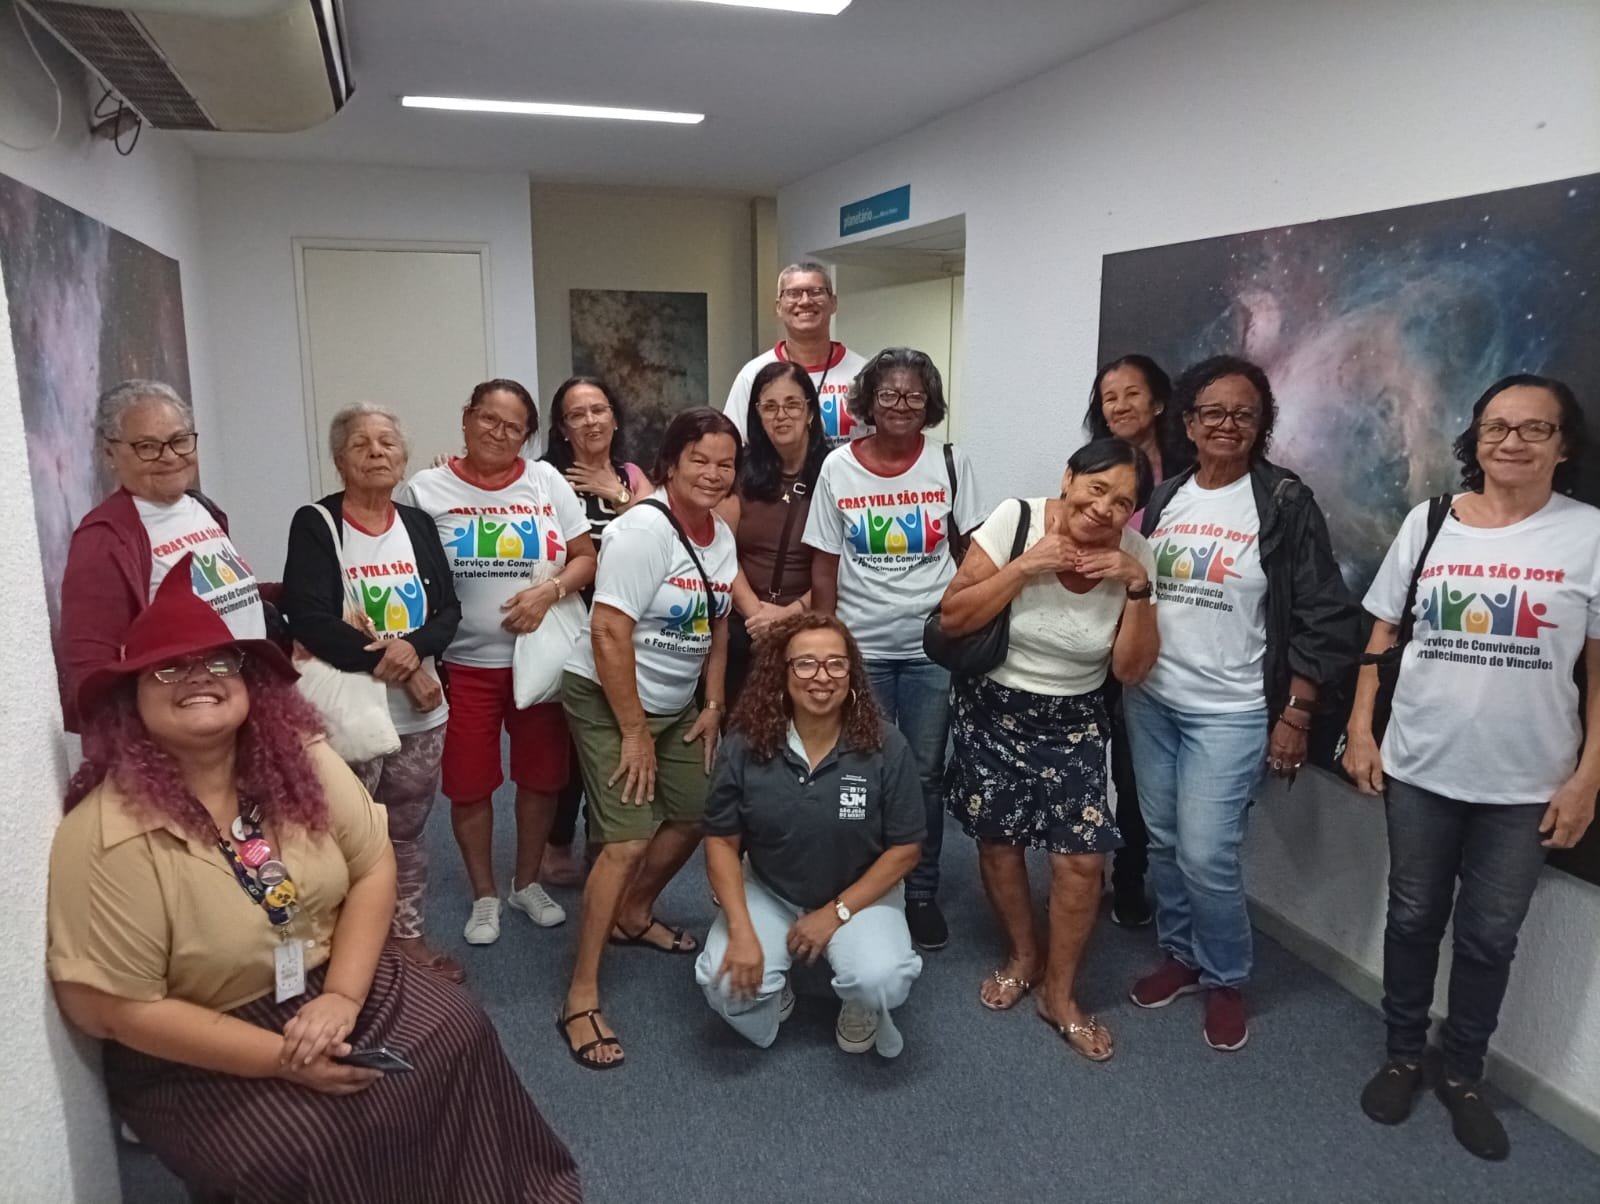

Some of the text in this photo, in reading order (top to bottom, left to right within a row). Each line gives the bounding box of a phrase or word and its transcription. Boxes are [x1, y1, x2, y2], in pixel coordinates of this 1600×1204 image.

[838, 488, 946, 510] CRAS VILA SÃO JOSÉ
[1173, 524, 1198, 535] VILA
[1200, 523, 1224, 537] SÃO
[153, 538, 185, 557] CRAS
[454, 559, 490, 568] Serviço
[492, 559, 504, 567] de
[884, 555, 894, 563] de
[360, 563, 391, 578] VILA
[390, 560, 414, 575] SÃO
[519, 570, 530, 578] de
[1447, 564, 1484, 577] VILA
[1488, 563, 1521, 579] SÃO
[1523, 567, 1566, 583] JOSÉ
[1455, 638, 1469, 650] de
[1471, 640, 1540, 656] Convivência
[1489, 655, 1504, 667] de
[840, 793, 866, 806] SJM
